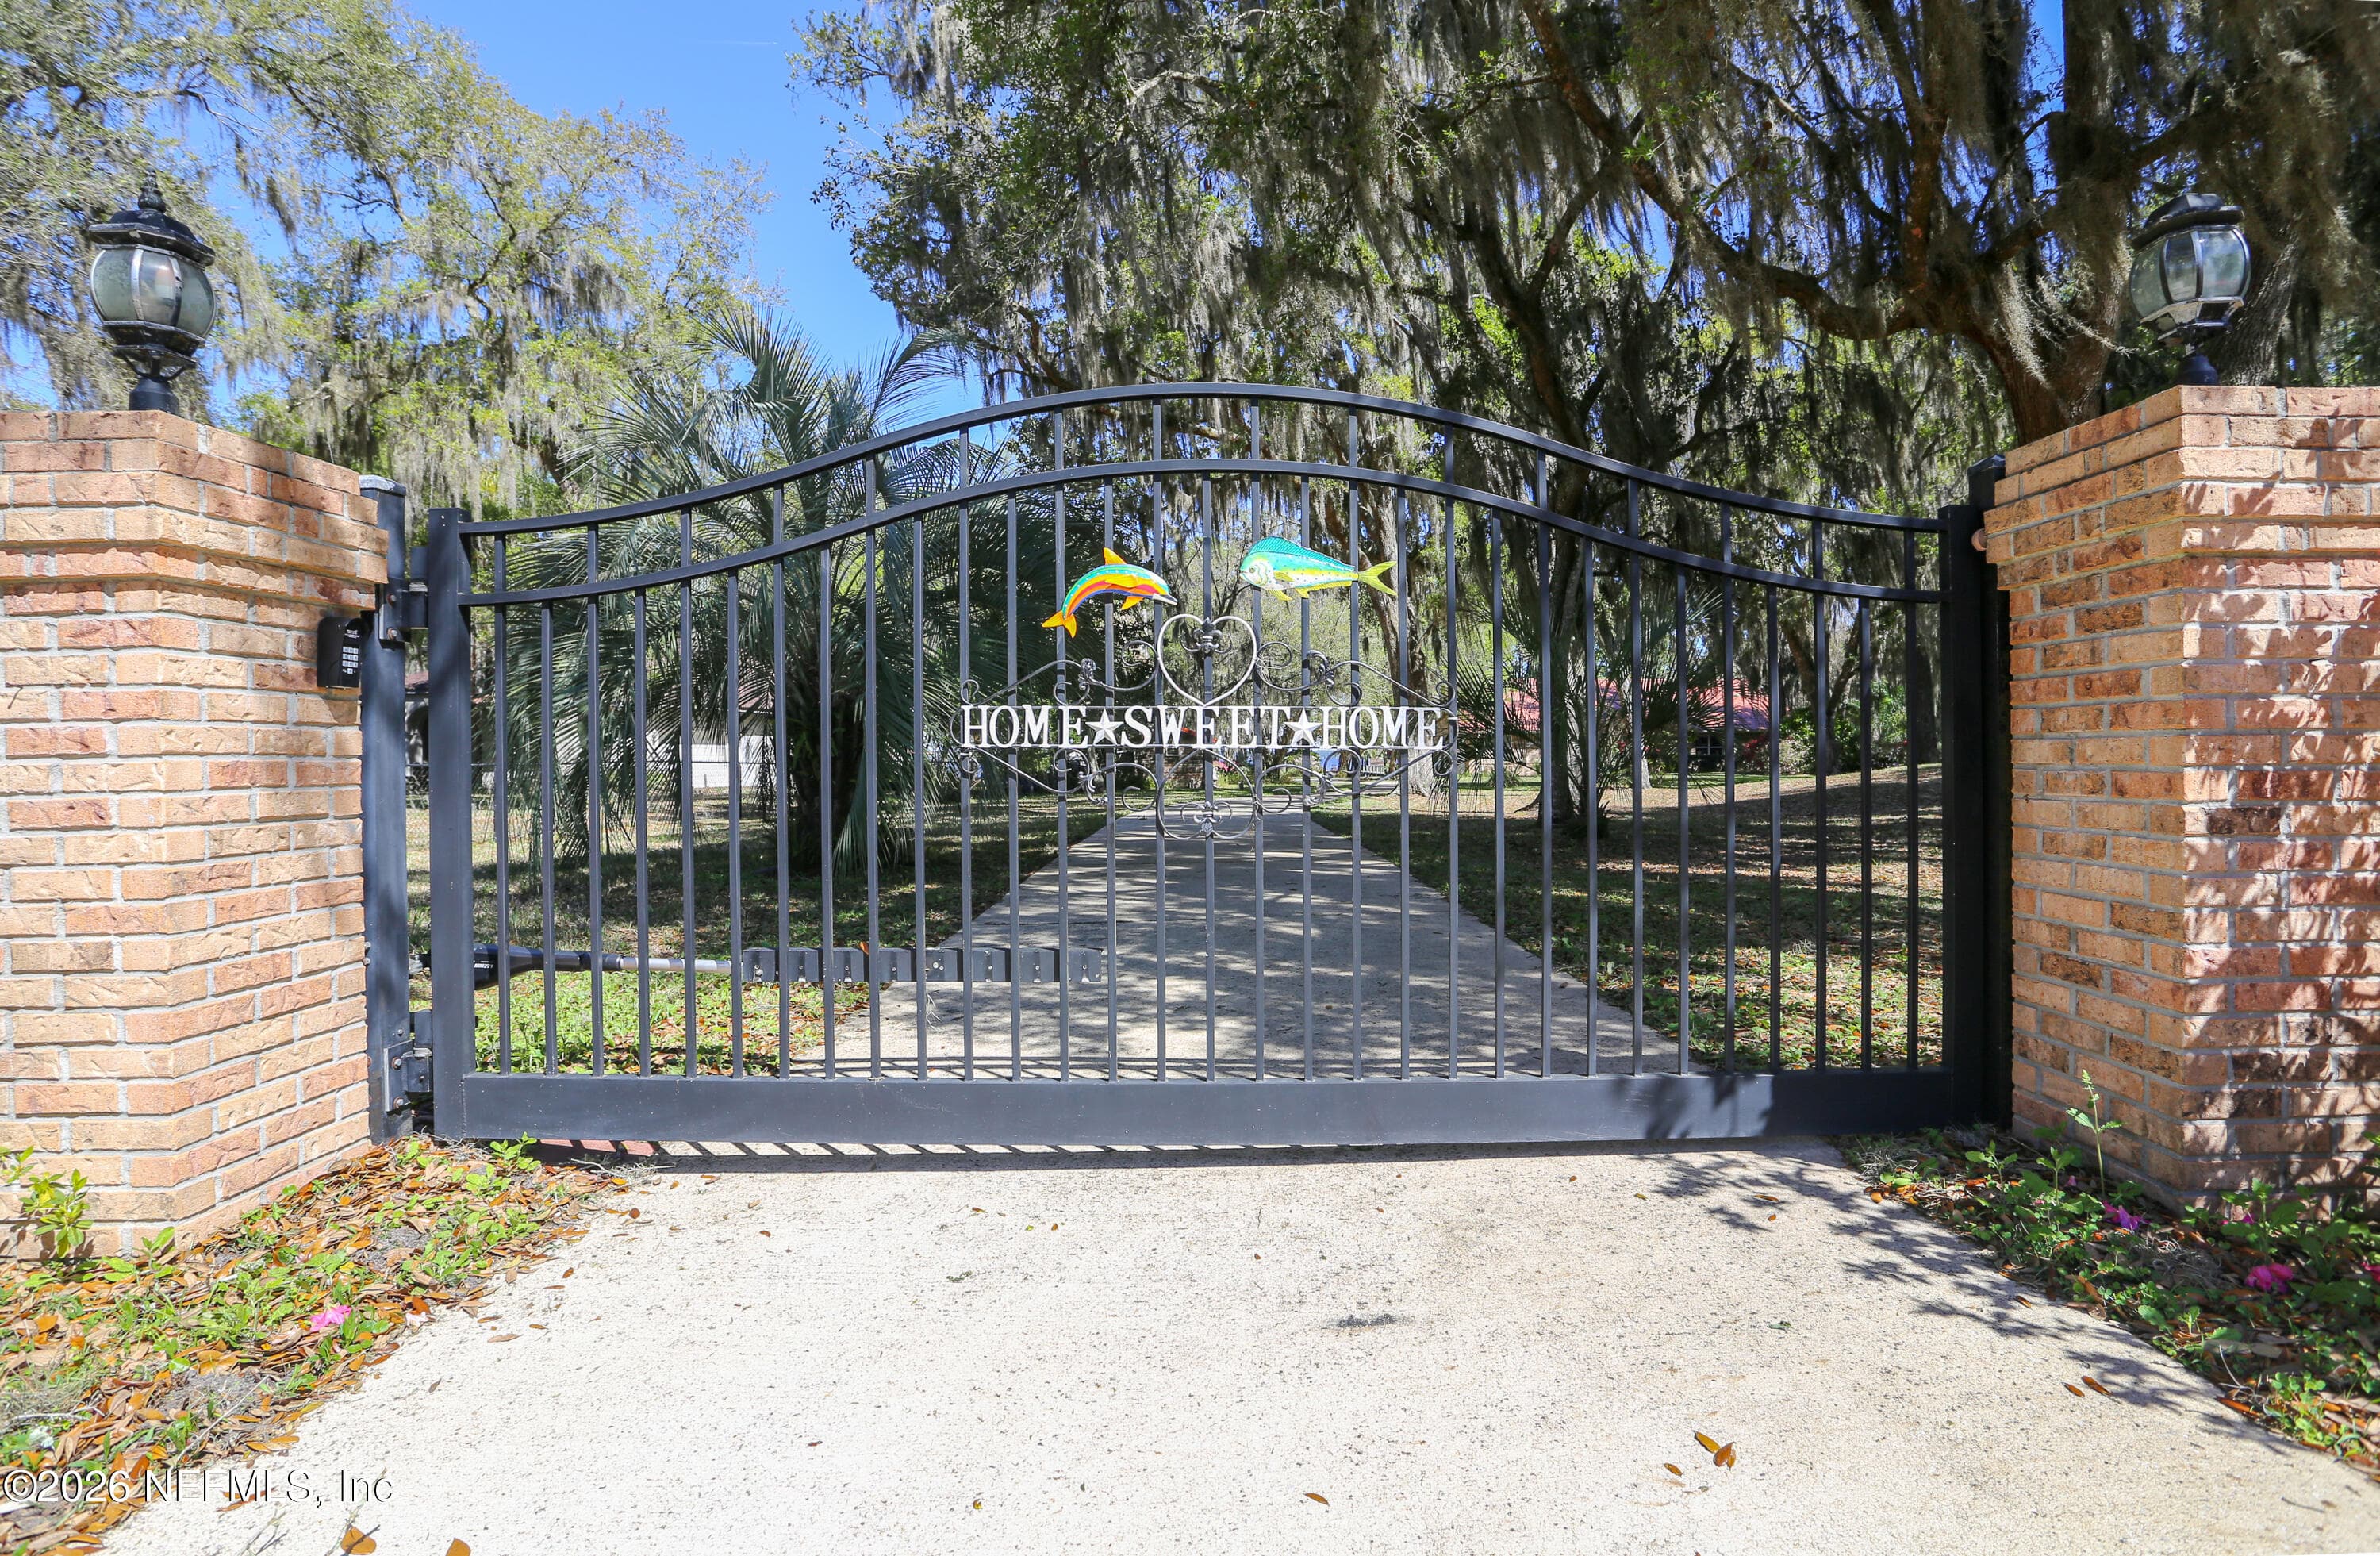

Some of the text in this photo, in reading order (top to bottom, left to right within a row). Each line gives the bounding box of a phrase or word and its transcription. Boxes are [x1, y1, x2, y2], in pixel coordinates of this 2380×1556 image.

[962, 705, 1444, 750] HOME SWEET HOME
